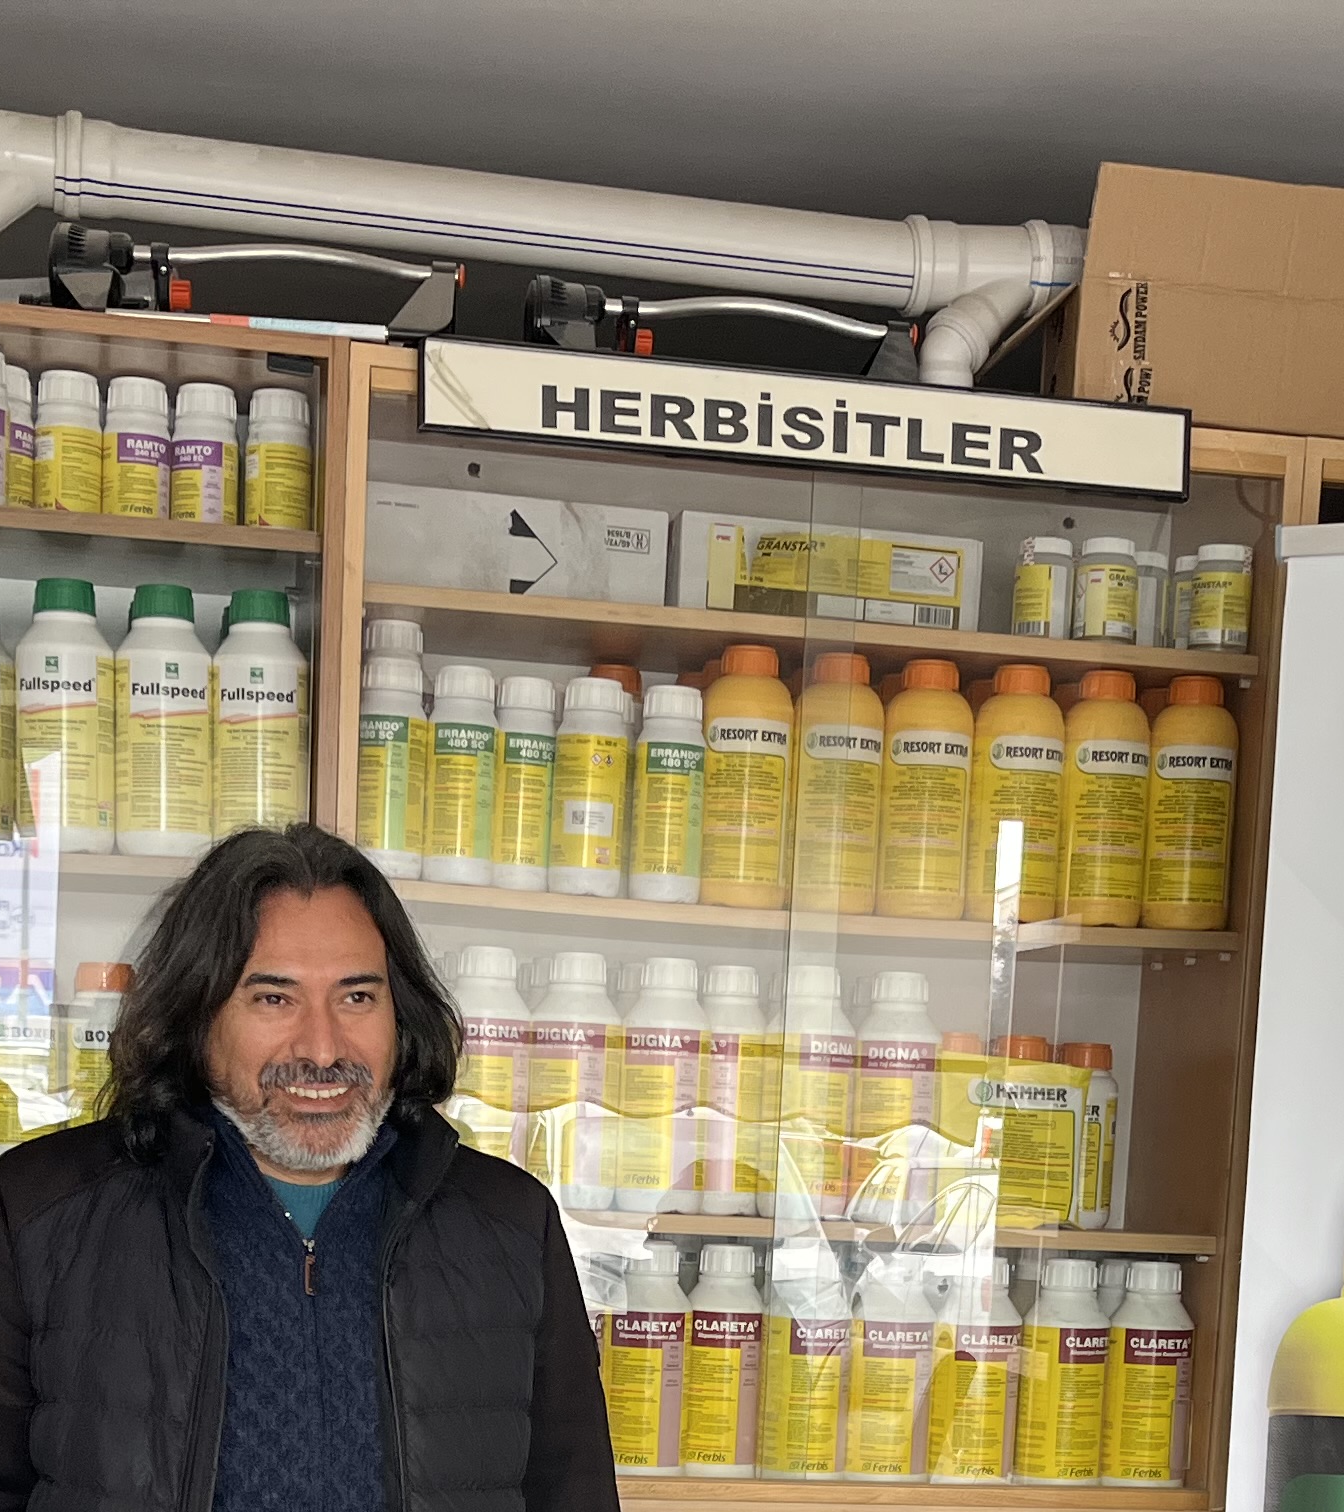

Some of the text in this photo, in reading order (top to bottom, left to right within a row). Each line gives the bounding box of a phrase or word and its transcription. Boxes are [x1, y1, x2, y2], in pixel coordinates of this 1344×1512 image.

[540, 384, 1044, 473] HERBİSİTLER
[19, 677, 93, 694] Fullspeed
[131, 682, 206, 701] Fullspeed
[220, 688, 295, 704] Fullspeed
[438, 728, 492, 743] ERRANDO
[720, 727, 759, 741] RESORT
[1168, 755, 1207, 769] RESORT
[631, 1033, 683, 1049] DIGNA
[868, 1046, 921, 1062] DIGNA
[615, 1319, 675, 1333] CLARETA
[868, 1329, 927, 1344] CLARETA
[1130, 1337, 1189, 1352] CLARETA
